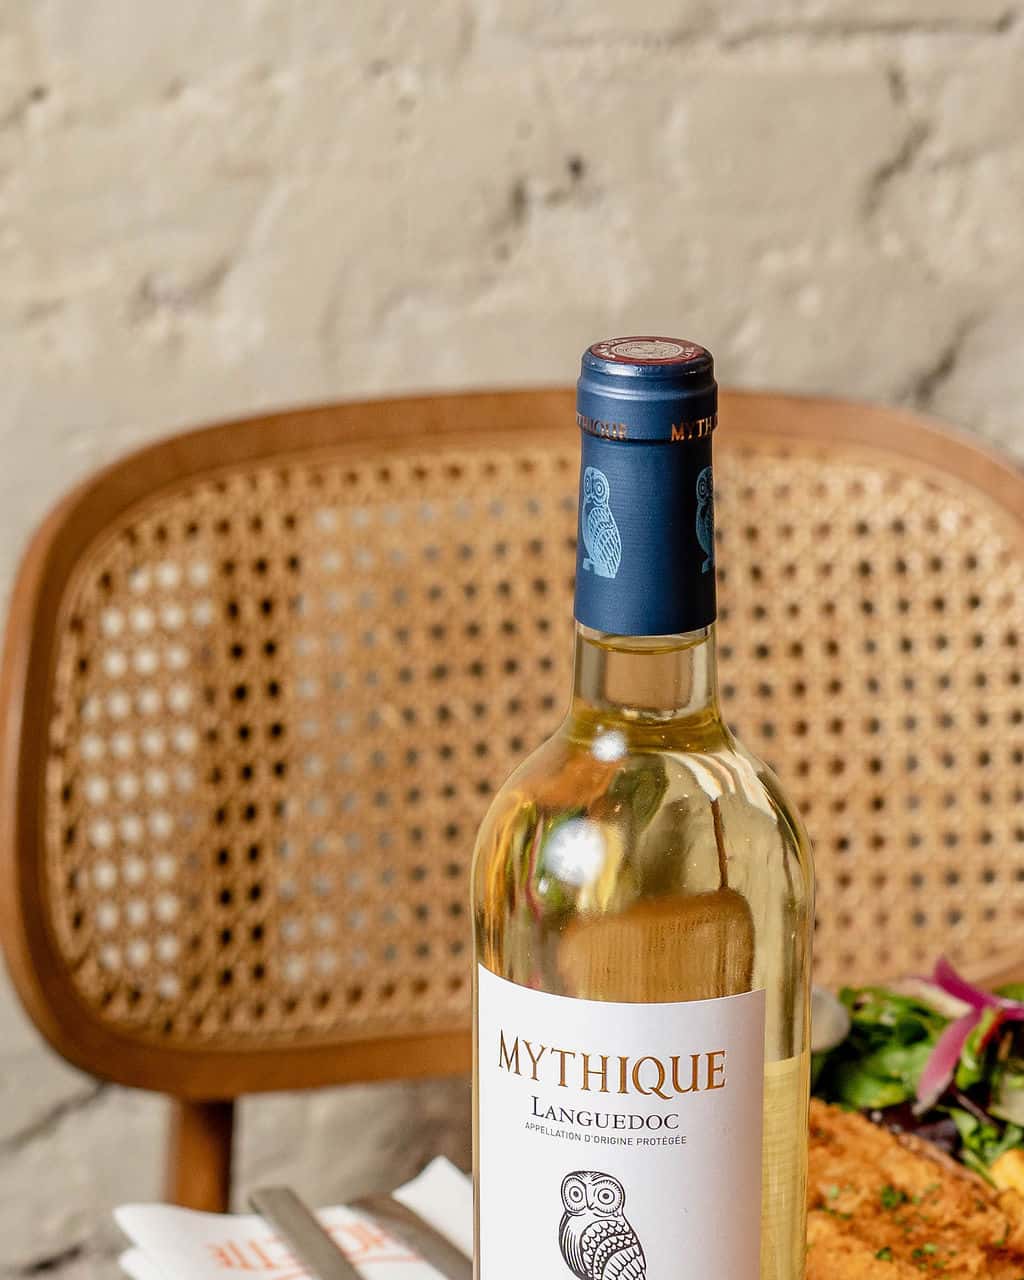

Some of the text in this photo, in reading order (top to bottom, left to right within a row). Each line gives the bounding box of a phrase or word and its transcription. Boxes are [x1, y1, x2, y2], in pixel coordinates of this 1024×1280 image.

[498, 1028, 728, 1101] MYTHIQUE
[524, 1121, 687, 1147] APPELLATION D'ORIGINE PROTÉGÉE
